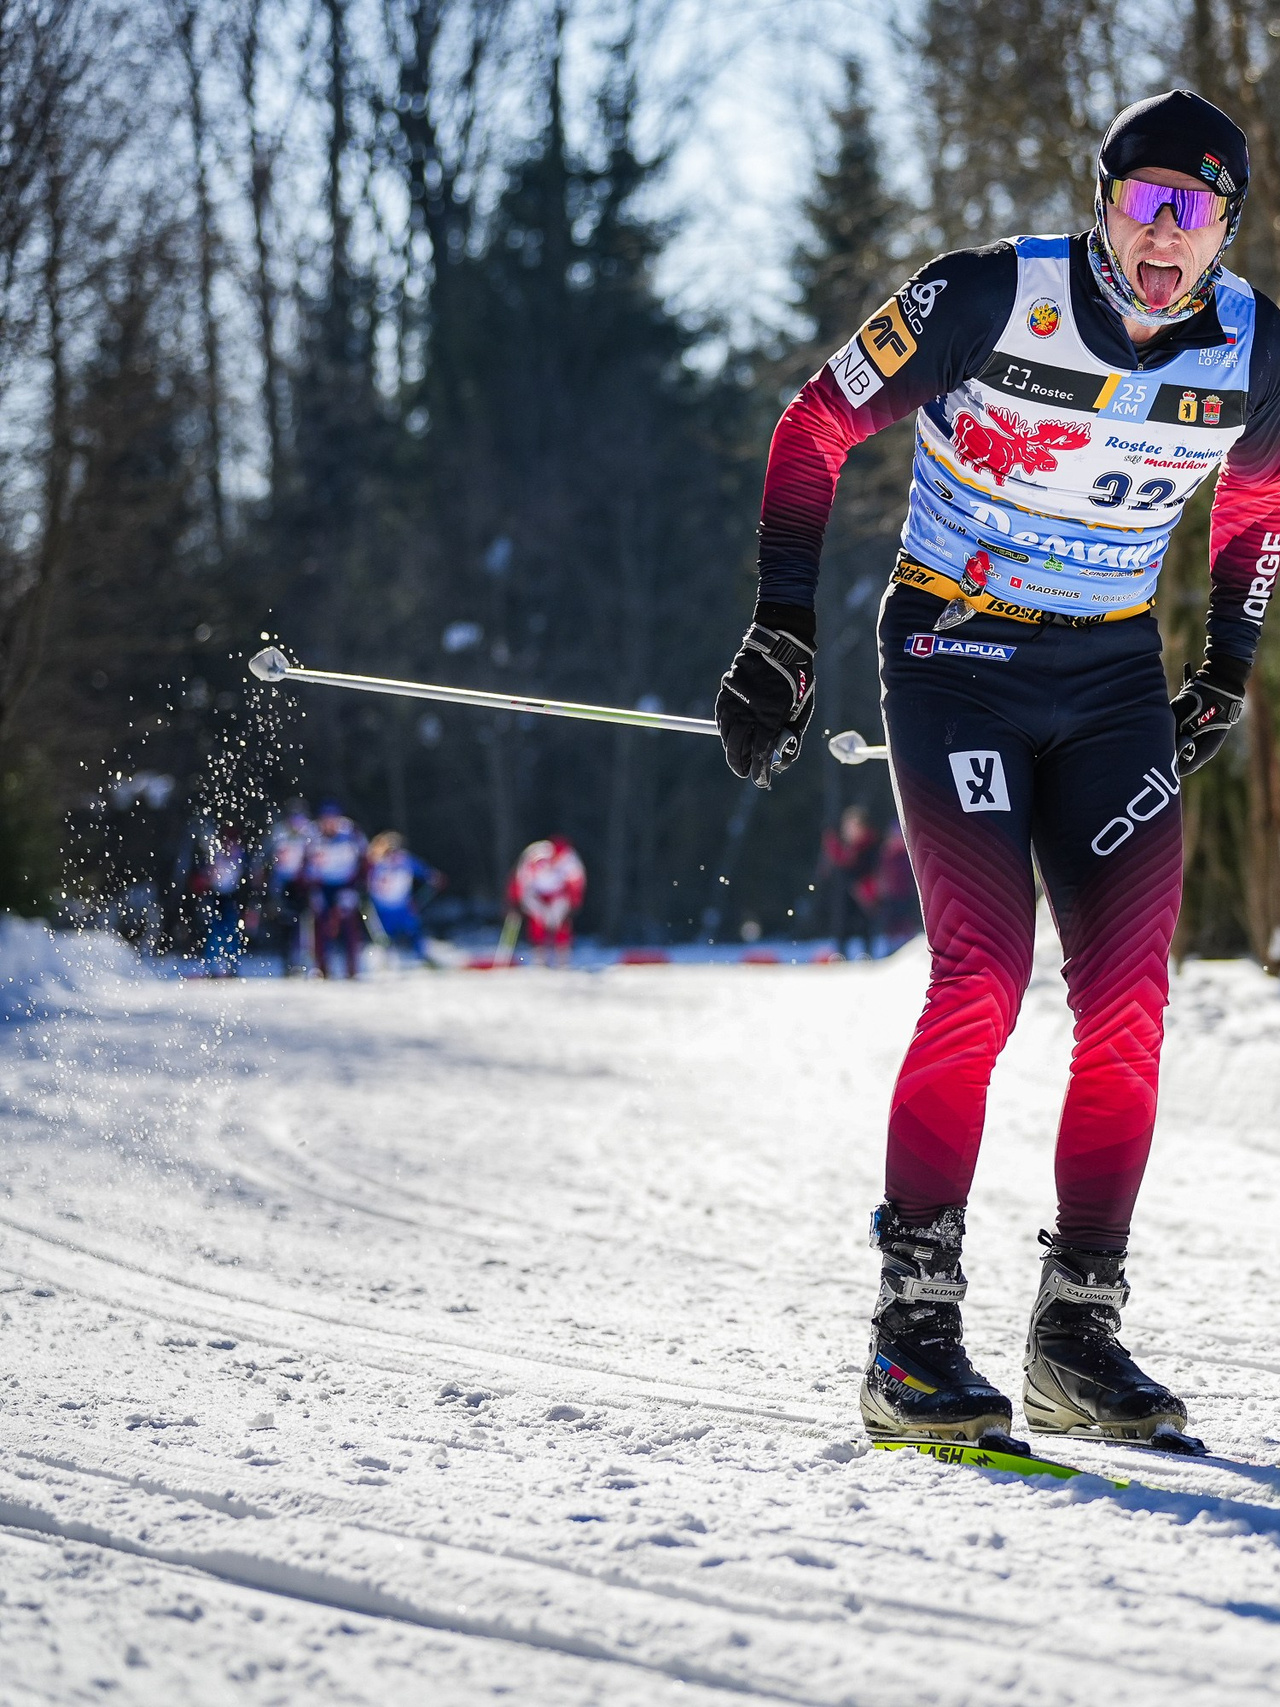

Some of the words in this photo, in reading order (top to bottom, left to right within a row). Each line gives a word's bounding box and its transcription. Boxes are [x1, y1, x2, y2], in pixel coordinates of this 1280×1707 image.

[1200, 348, 1238, 360] RUSSIA
[1030, 383, 1074, 401] Rostec
[1119, 383, 1148, 403] 25
[1112, 401, 1139, 416] KM
[1105, 436, 1163, 455] Rostec
[1144, 458, 1209, 470] marathon
[1088, 470, 1204, 511] 32
[1025, 583, 1081, 599] MADSHUS
[938, 640, 1007, 658] LAPUA
[1065, 1287, 1115, 1301] SALOMON
[873, 1364, 927, 1403] SALOMON
[906, 1444, 965, 1464] ASH
